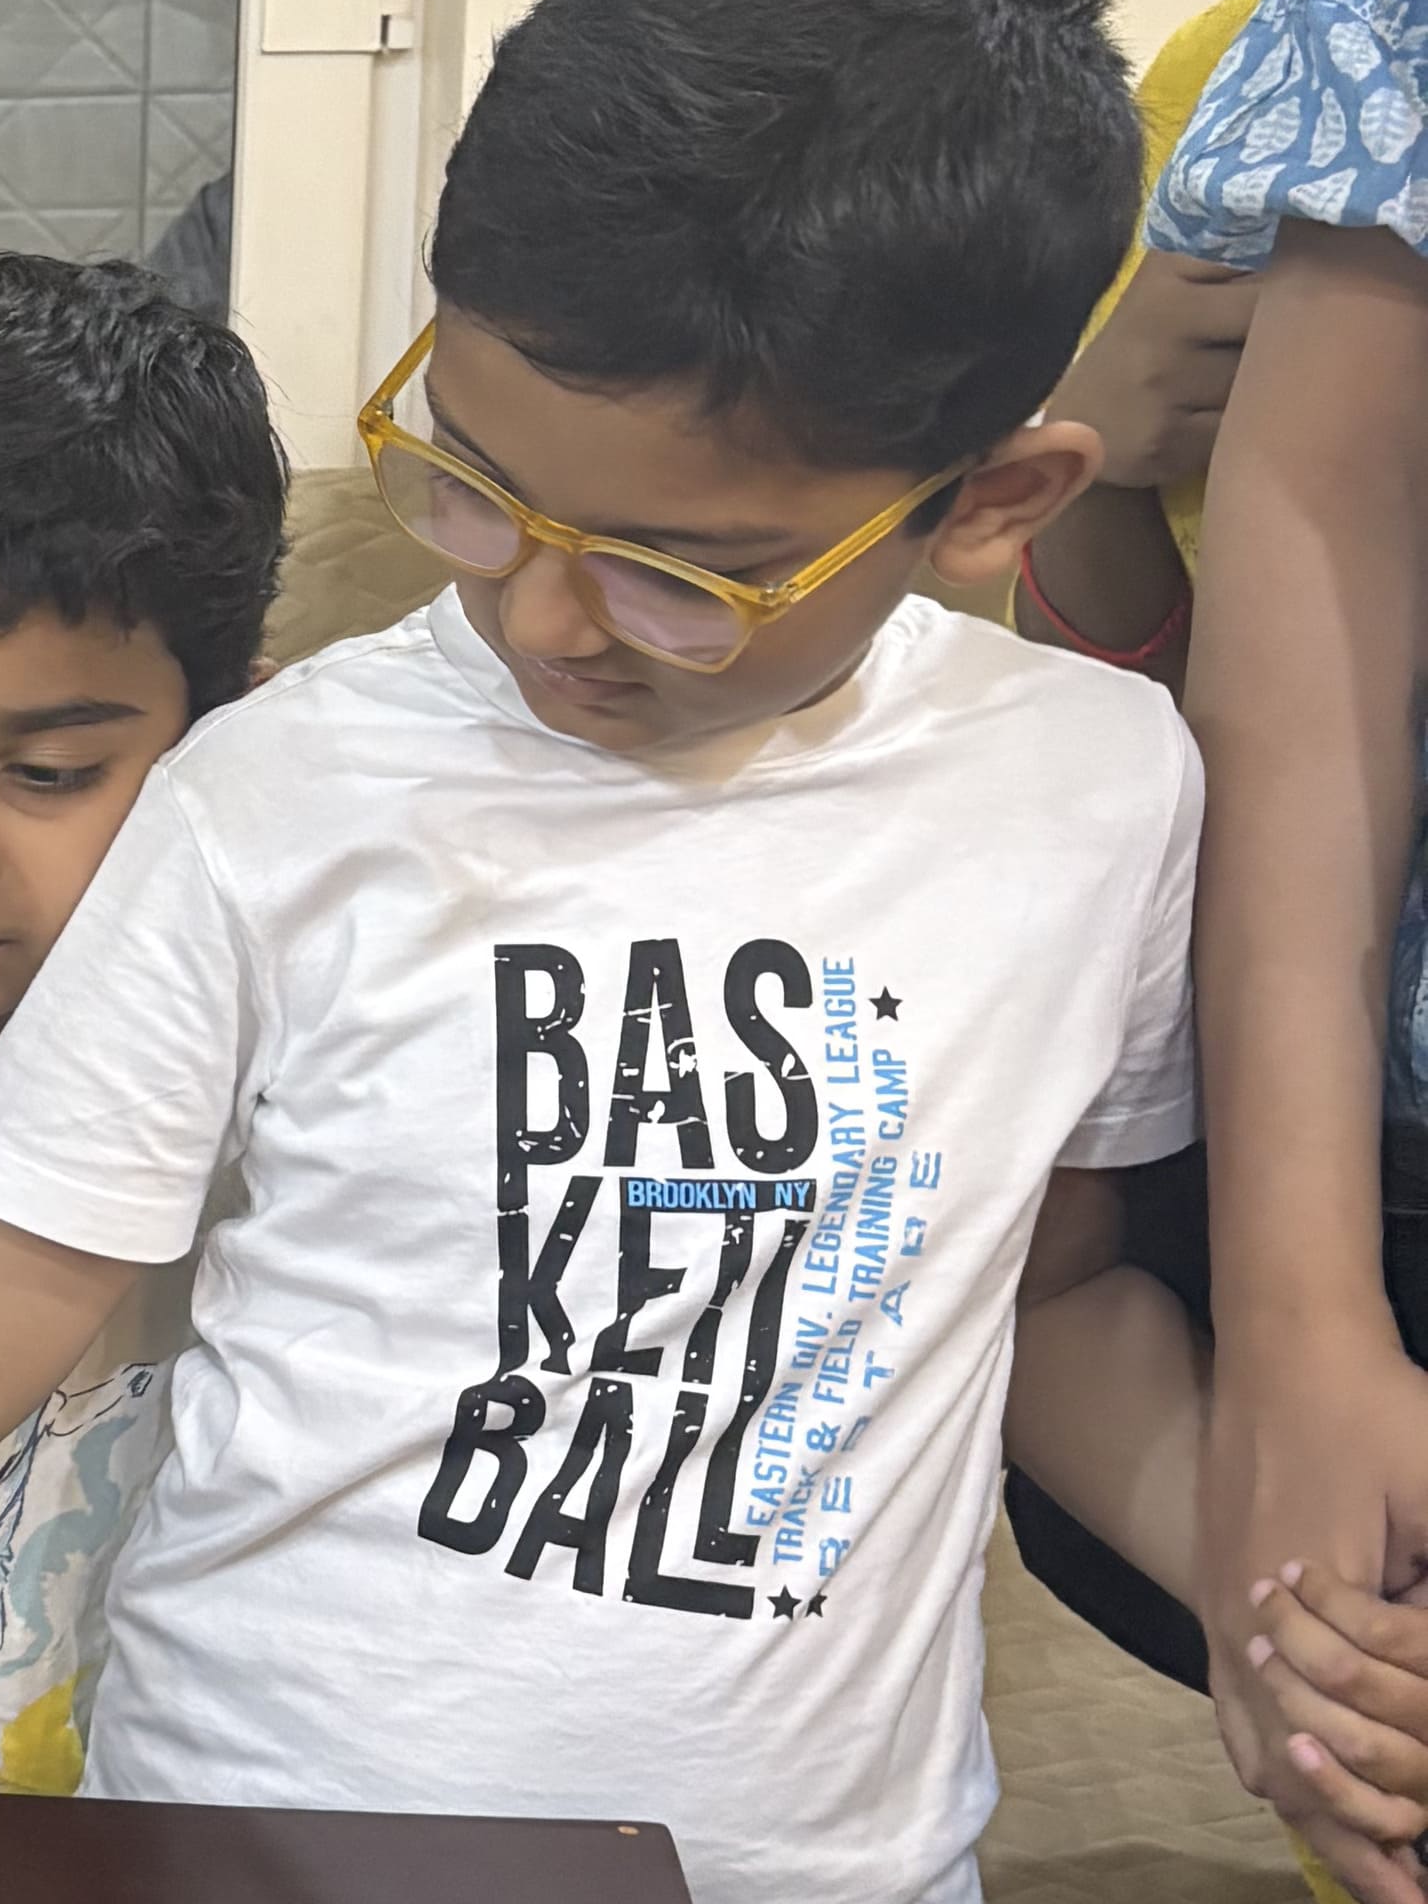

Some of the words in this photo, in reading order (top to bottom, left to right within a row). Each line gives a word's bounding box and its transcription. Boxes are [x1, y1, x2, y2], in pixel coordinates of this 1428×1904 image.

[493, 938, 820, 1177] BAS
[821, 956, 861, 1085] LEAGUE
[872, 1048, 910, 1141] CAMP
[627, 1179, 758, 1211] BROOKLYN
[774, 1180, 813, 1210] NY
[800, 1102, 865, 1295] LEGENDARY
[846, 1155, 899, 1304] TRAINING
[790, 1311, 834, 1370] DIV.
[811, 1318, 863, 1405] FIELD
[746, 1381, 804, 1528] EASTERN
[806, 1420, 842, 1453] &
[772, 1462, 823, 1566] TRACK
